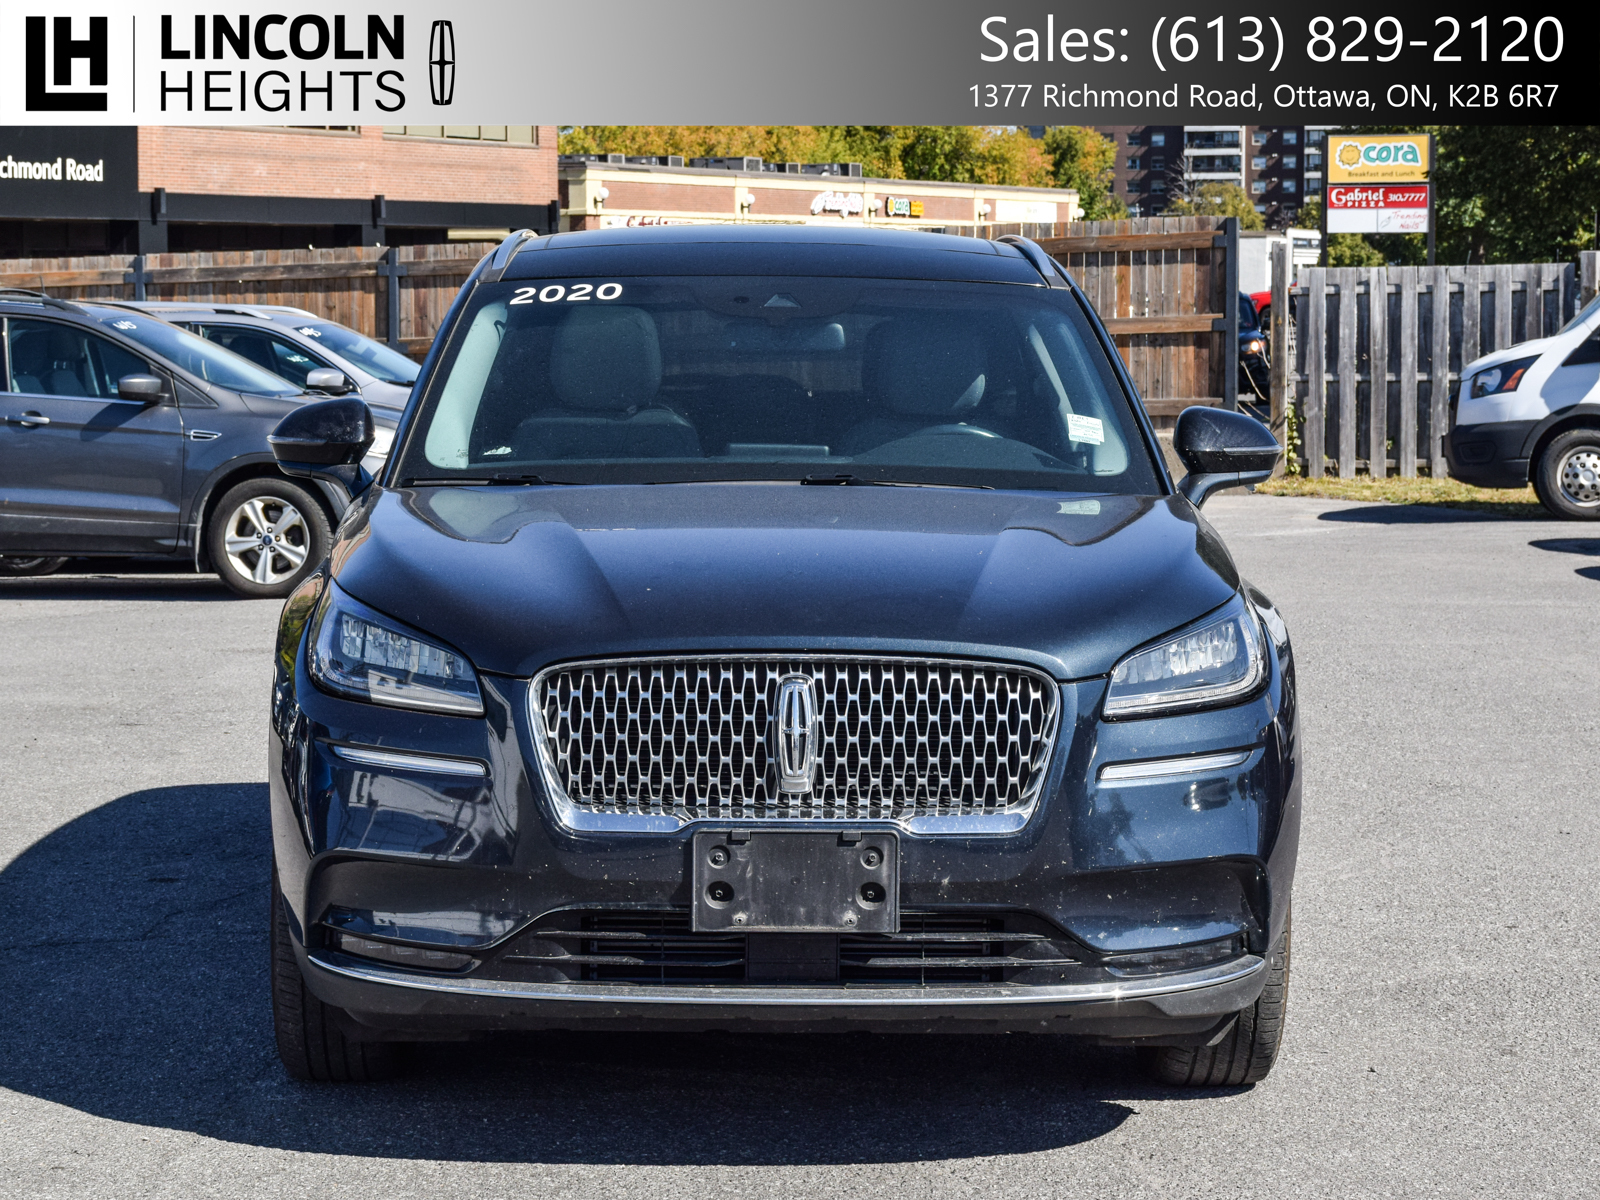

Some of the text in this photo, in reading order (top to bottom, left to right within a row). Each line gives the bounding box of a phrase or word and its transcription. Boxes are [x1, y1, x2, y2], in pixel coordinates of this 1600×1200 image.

[1363, 143, 1419, 163] cora
[66, 158, 104, 182] Road
[1331, 188, 1385, 205] Gabriel
[1399, 220, 1420, 230] Nails
[509, 282, 623, 305] 2020
